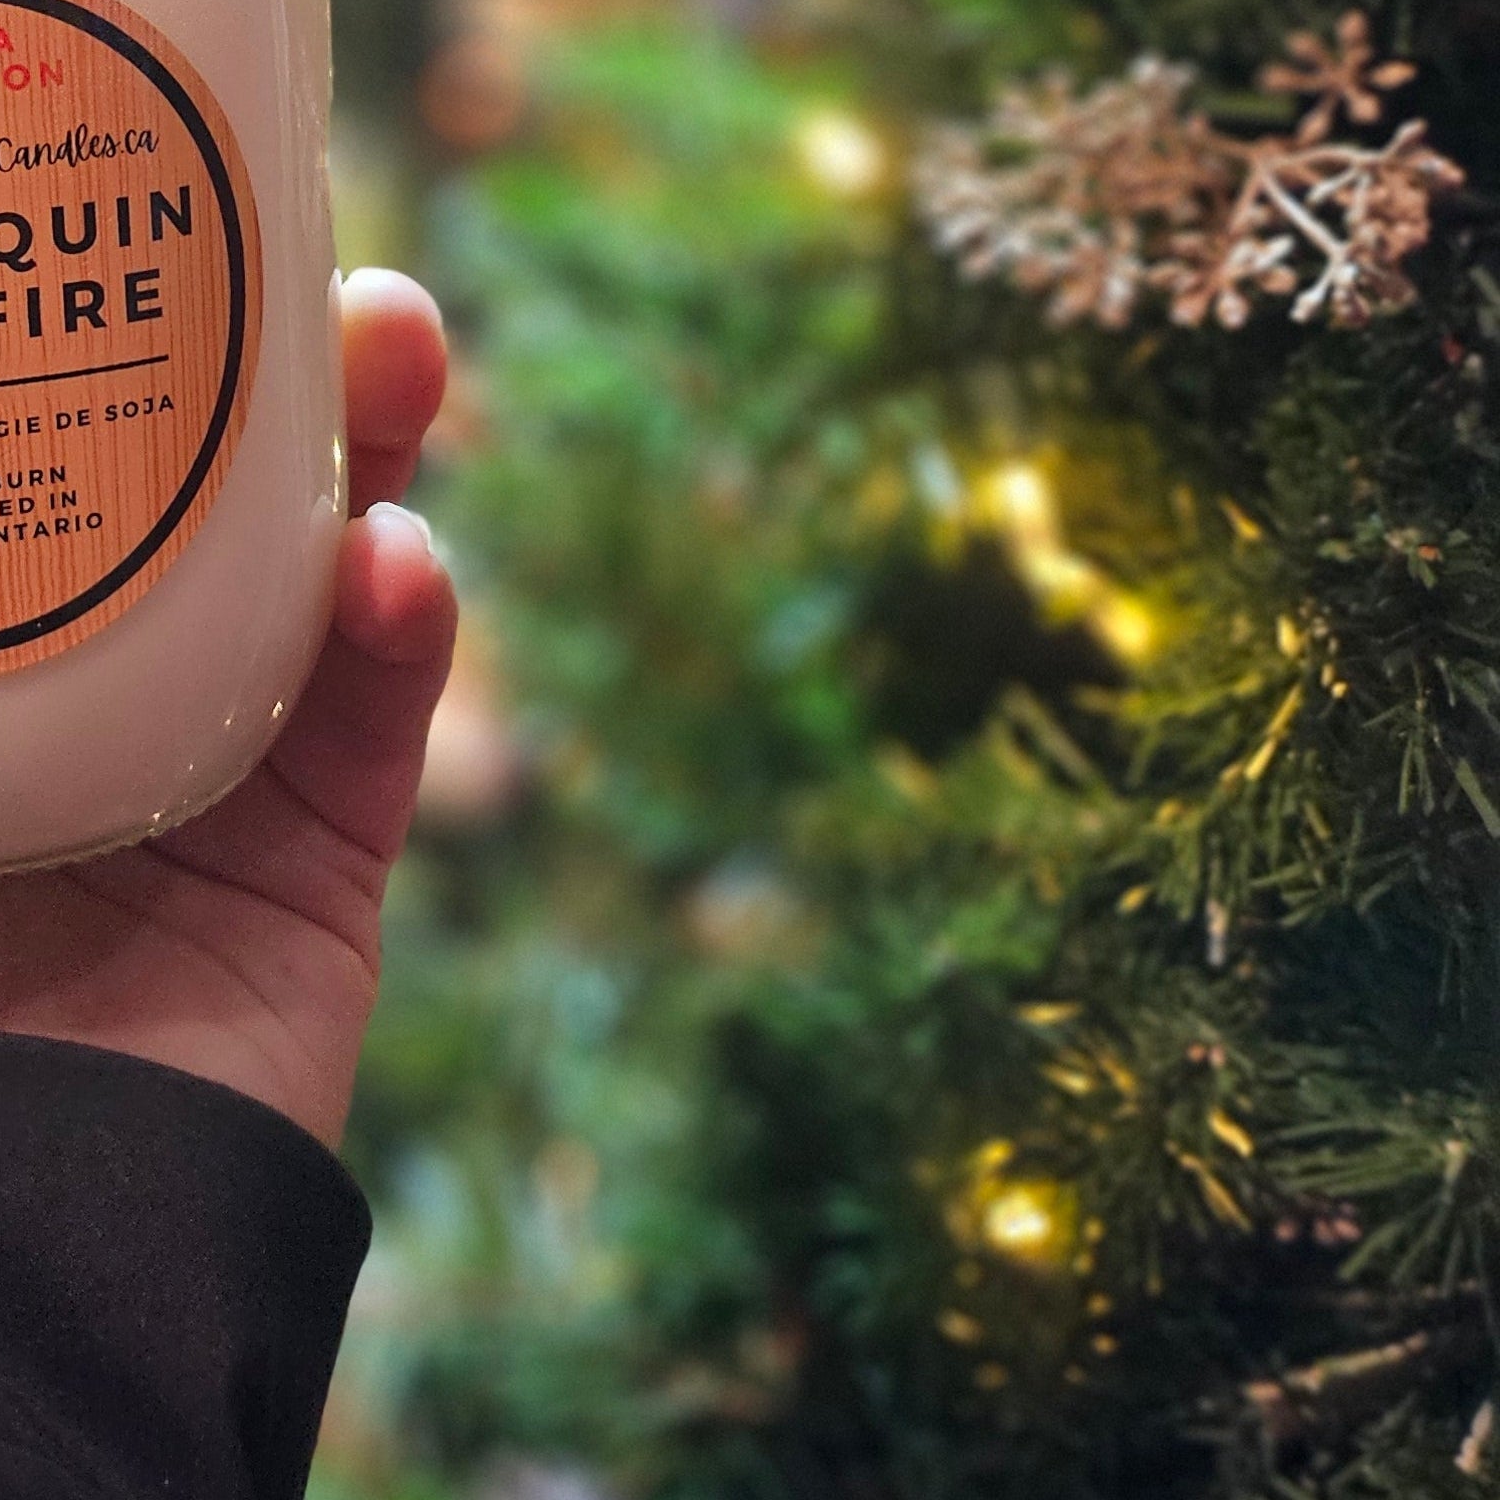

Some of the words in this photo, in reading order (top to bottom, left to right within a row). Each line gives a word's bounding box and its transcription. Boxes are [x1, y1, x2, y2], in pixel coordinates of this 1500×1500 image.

[55, 408, 91, 430] DE
[104, 394, 175, 424] SOJA
[49, 490, 78, 510] IN
